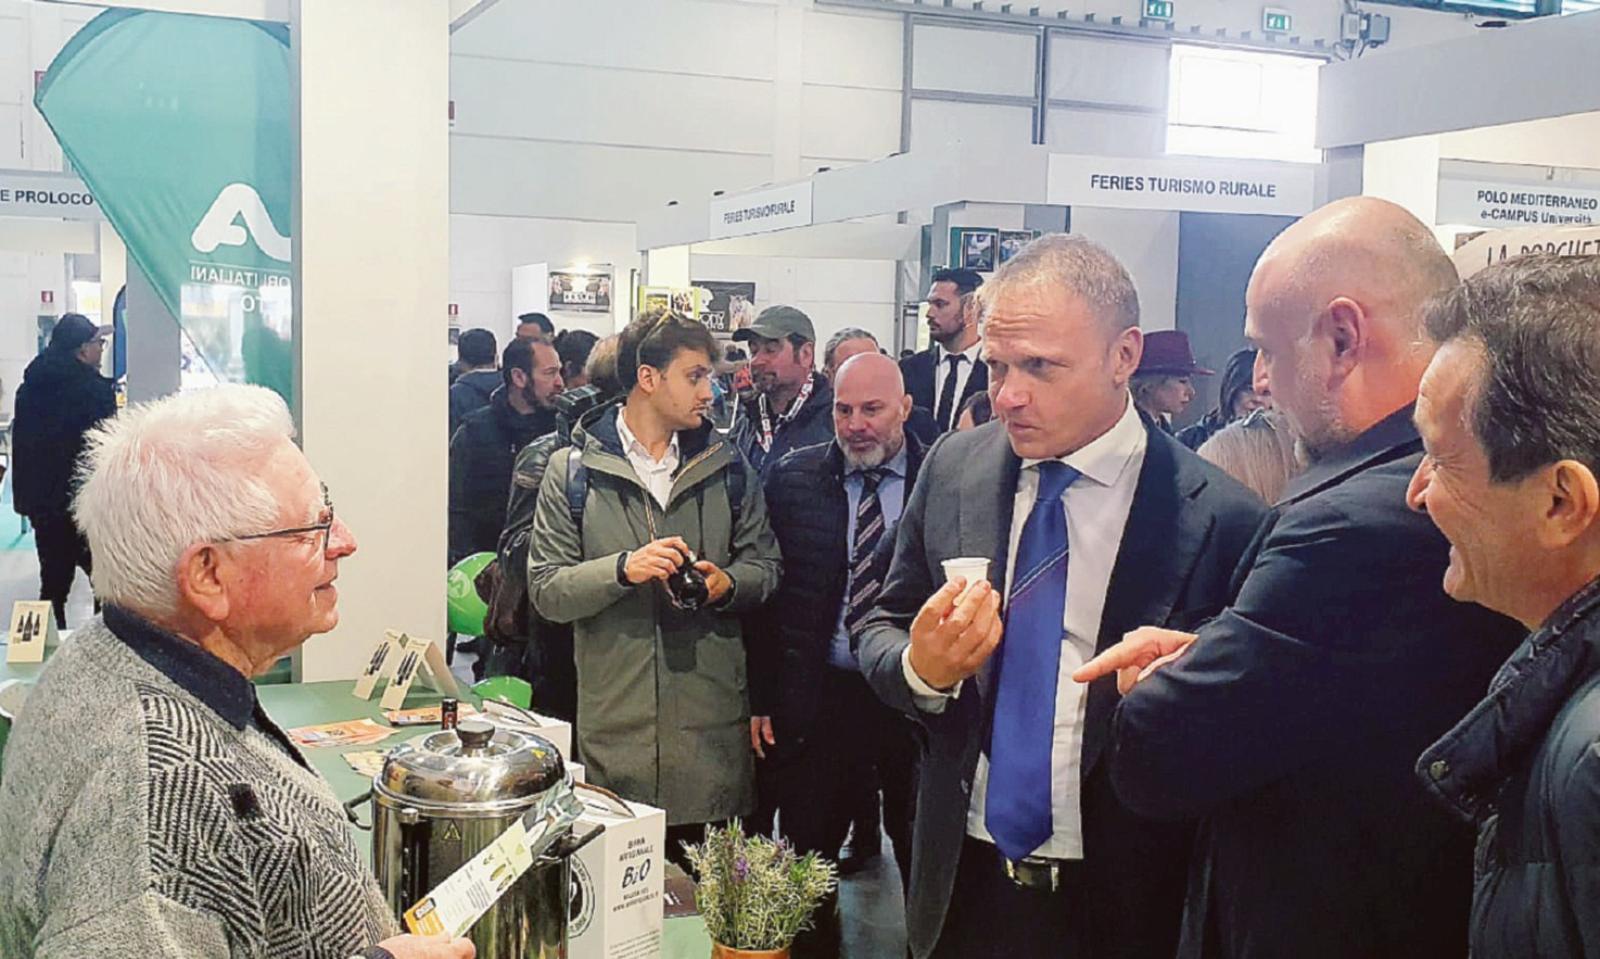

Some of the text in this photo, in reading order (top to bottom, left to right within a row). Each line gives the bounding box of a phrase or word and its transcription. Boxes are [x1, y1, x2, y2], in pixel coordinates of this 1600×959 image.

[1091, 174, 1276, 198] FERIES TURISMO RURALE
[15, 190, 94, 205] PROLOCO
[1477, 189, 1599, 210] POLO MEDITERRANEO
[1480, 208, 1538, 223] e-CAMPUS
